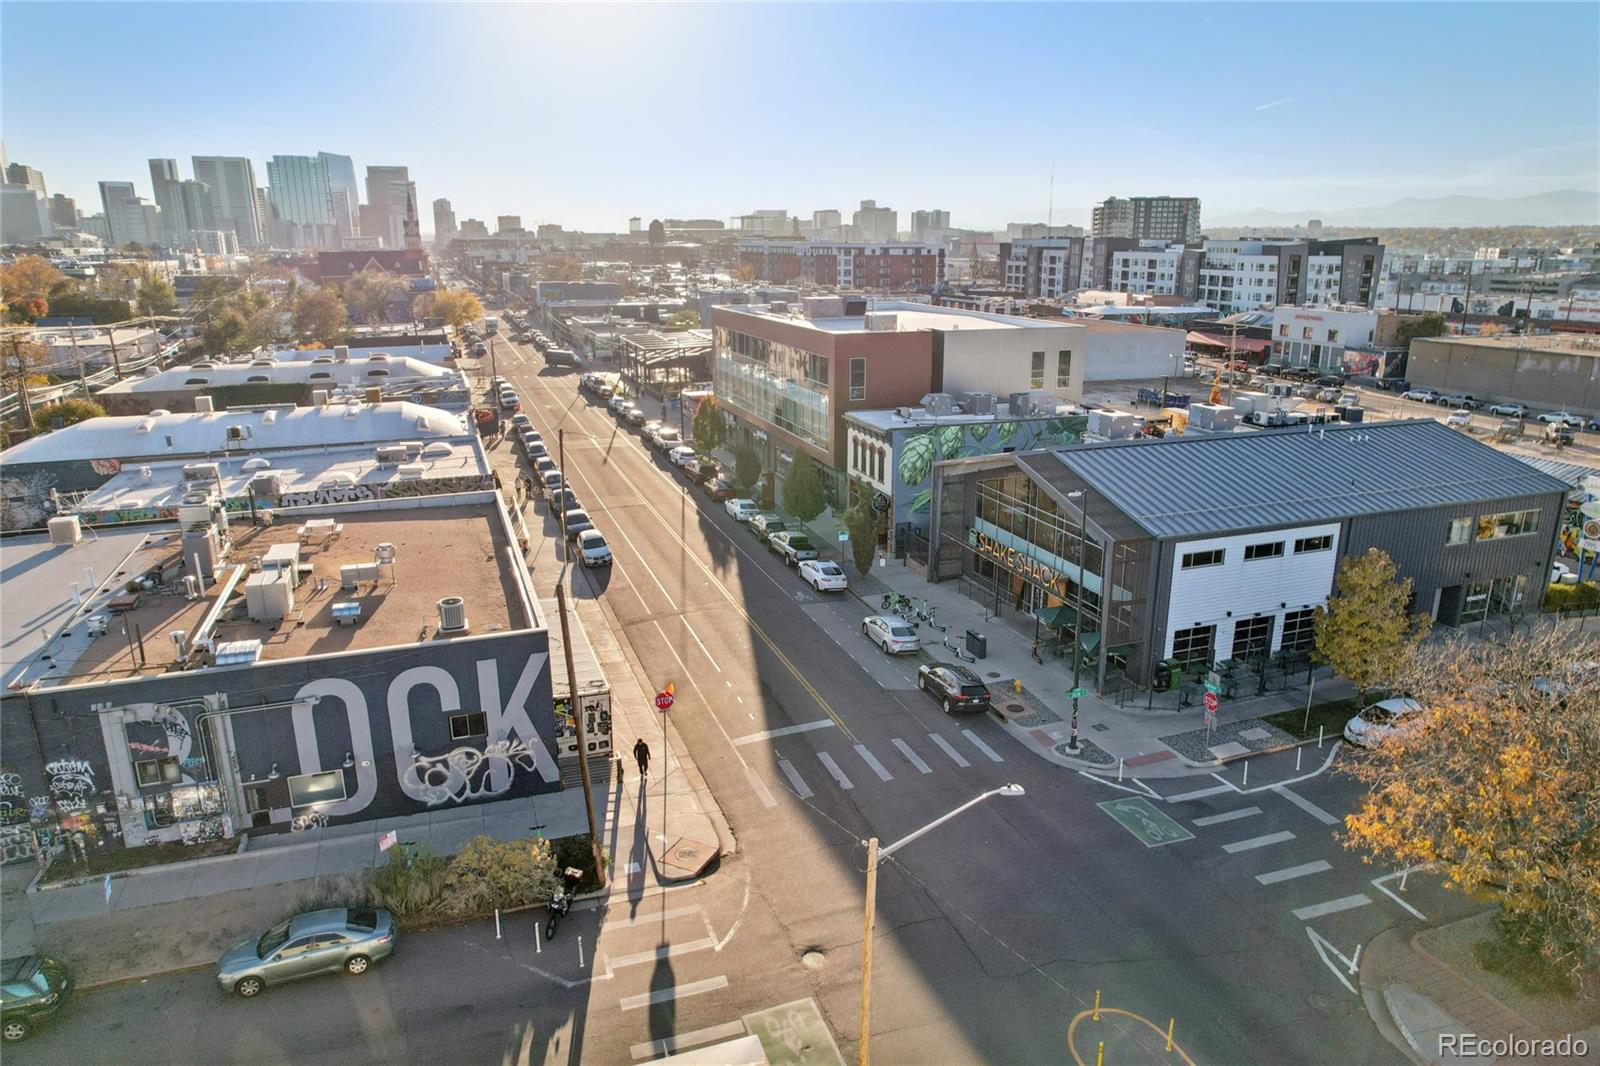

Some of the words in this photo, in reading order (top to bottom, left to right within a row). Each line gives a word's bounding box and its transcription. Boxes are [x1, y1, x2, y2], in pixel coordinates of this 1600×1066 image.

[979, 532, 1016, 569] SHAKE
[1016, 552, 1062, 595] SHACK
[655, 695, 674, 706] STOP
